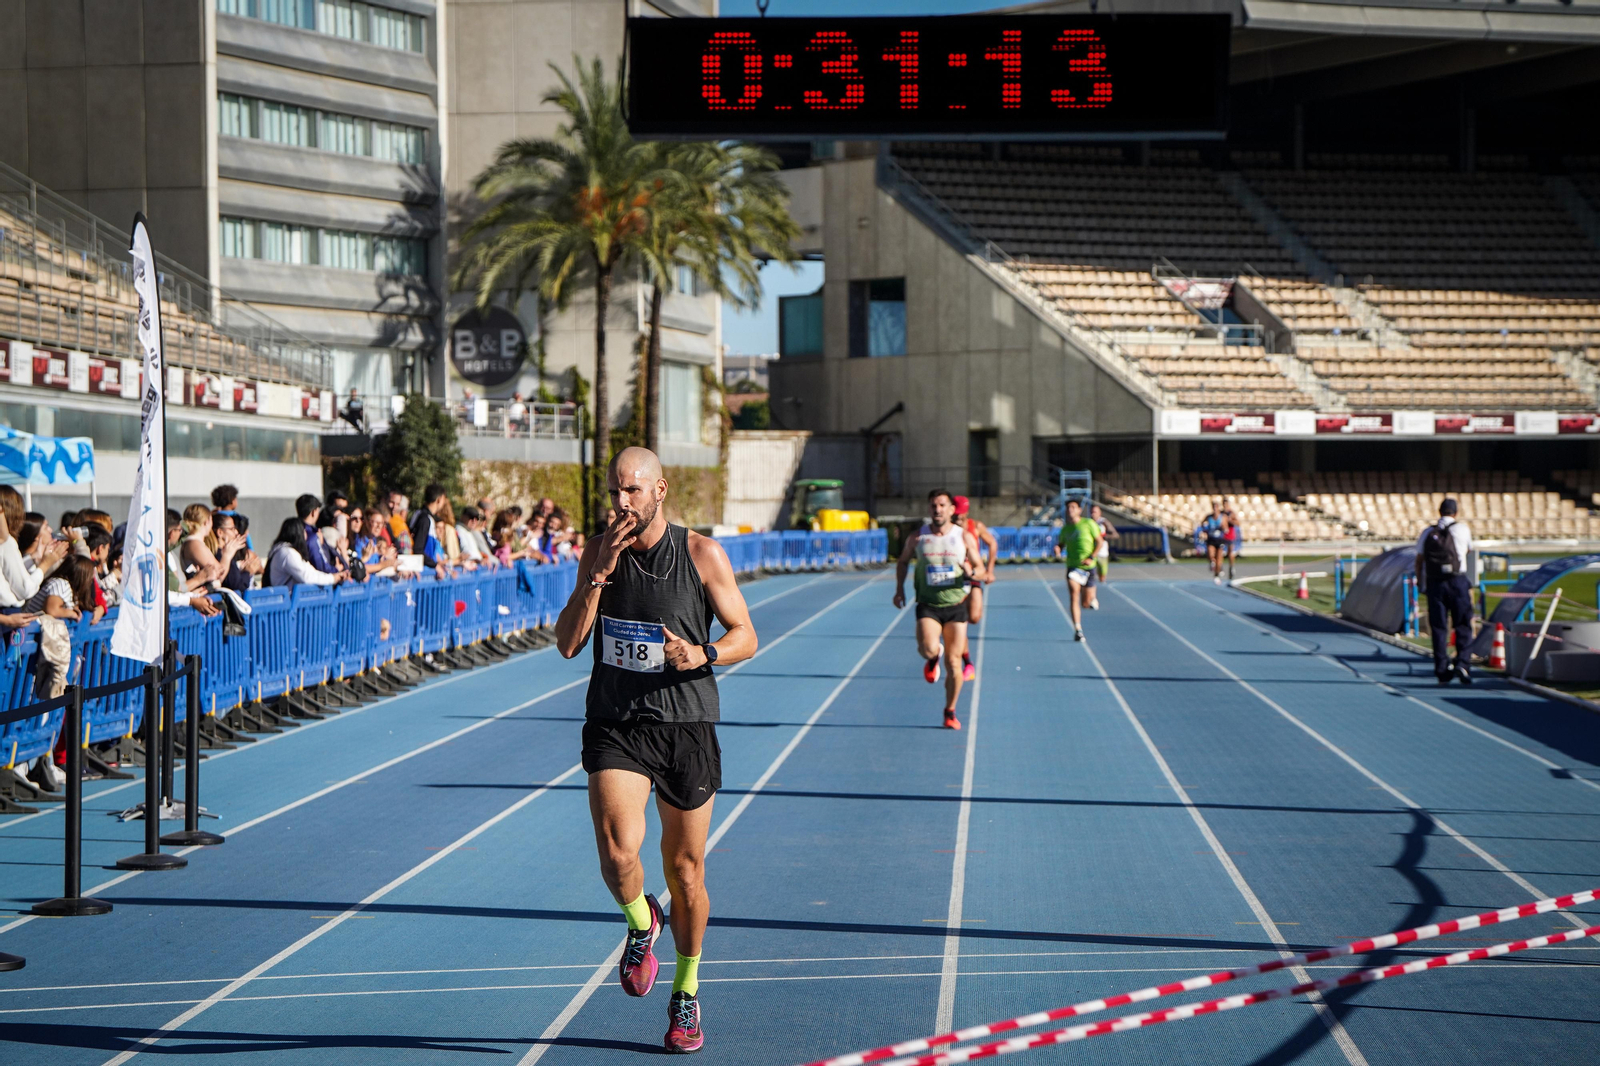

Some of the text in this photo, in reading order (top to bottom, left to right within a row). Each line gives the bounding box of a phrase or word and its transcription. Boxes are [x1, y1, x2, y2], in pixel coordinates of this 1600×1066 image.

[701, 29, 1113, 110] 0:31:13
[454, 329, 520, 359] B&B
[464, 360, 514, 372] HOTELS
[615, 640, 648, 661] 518
